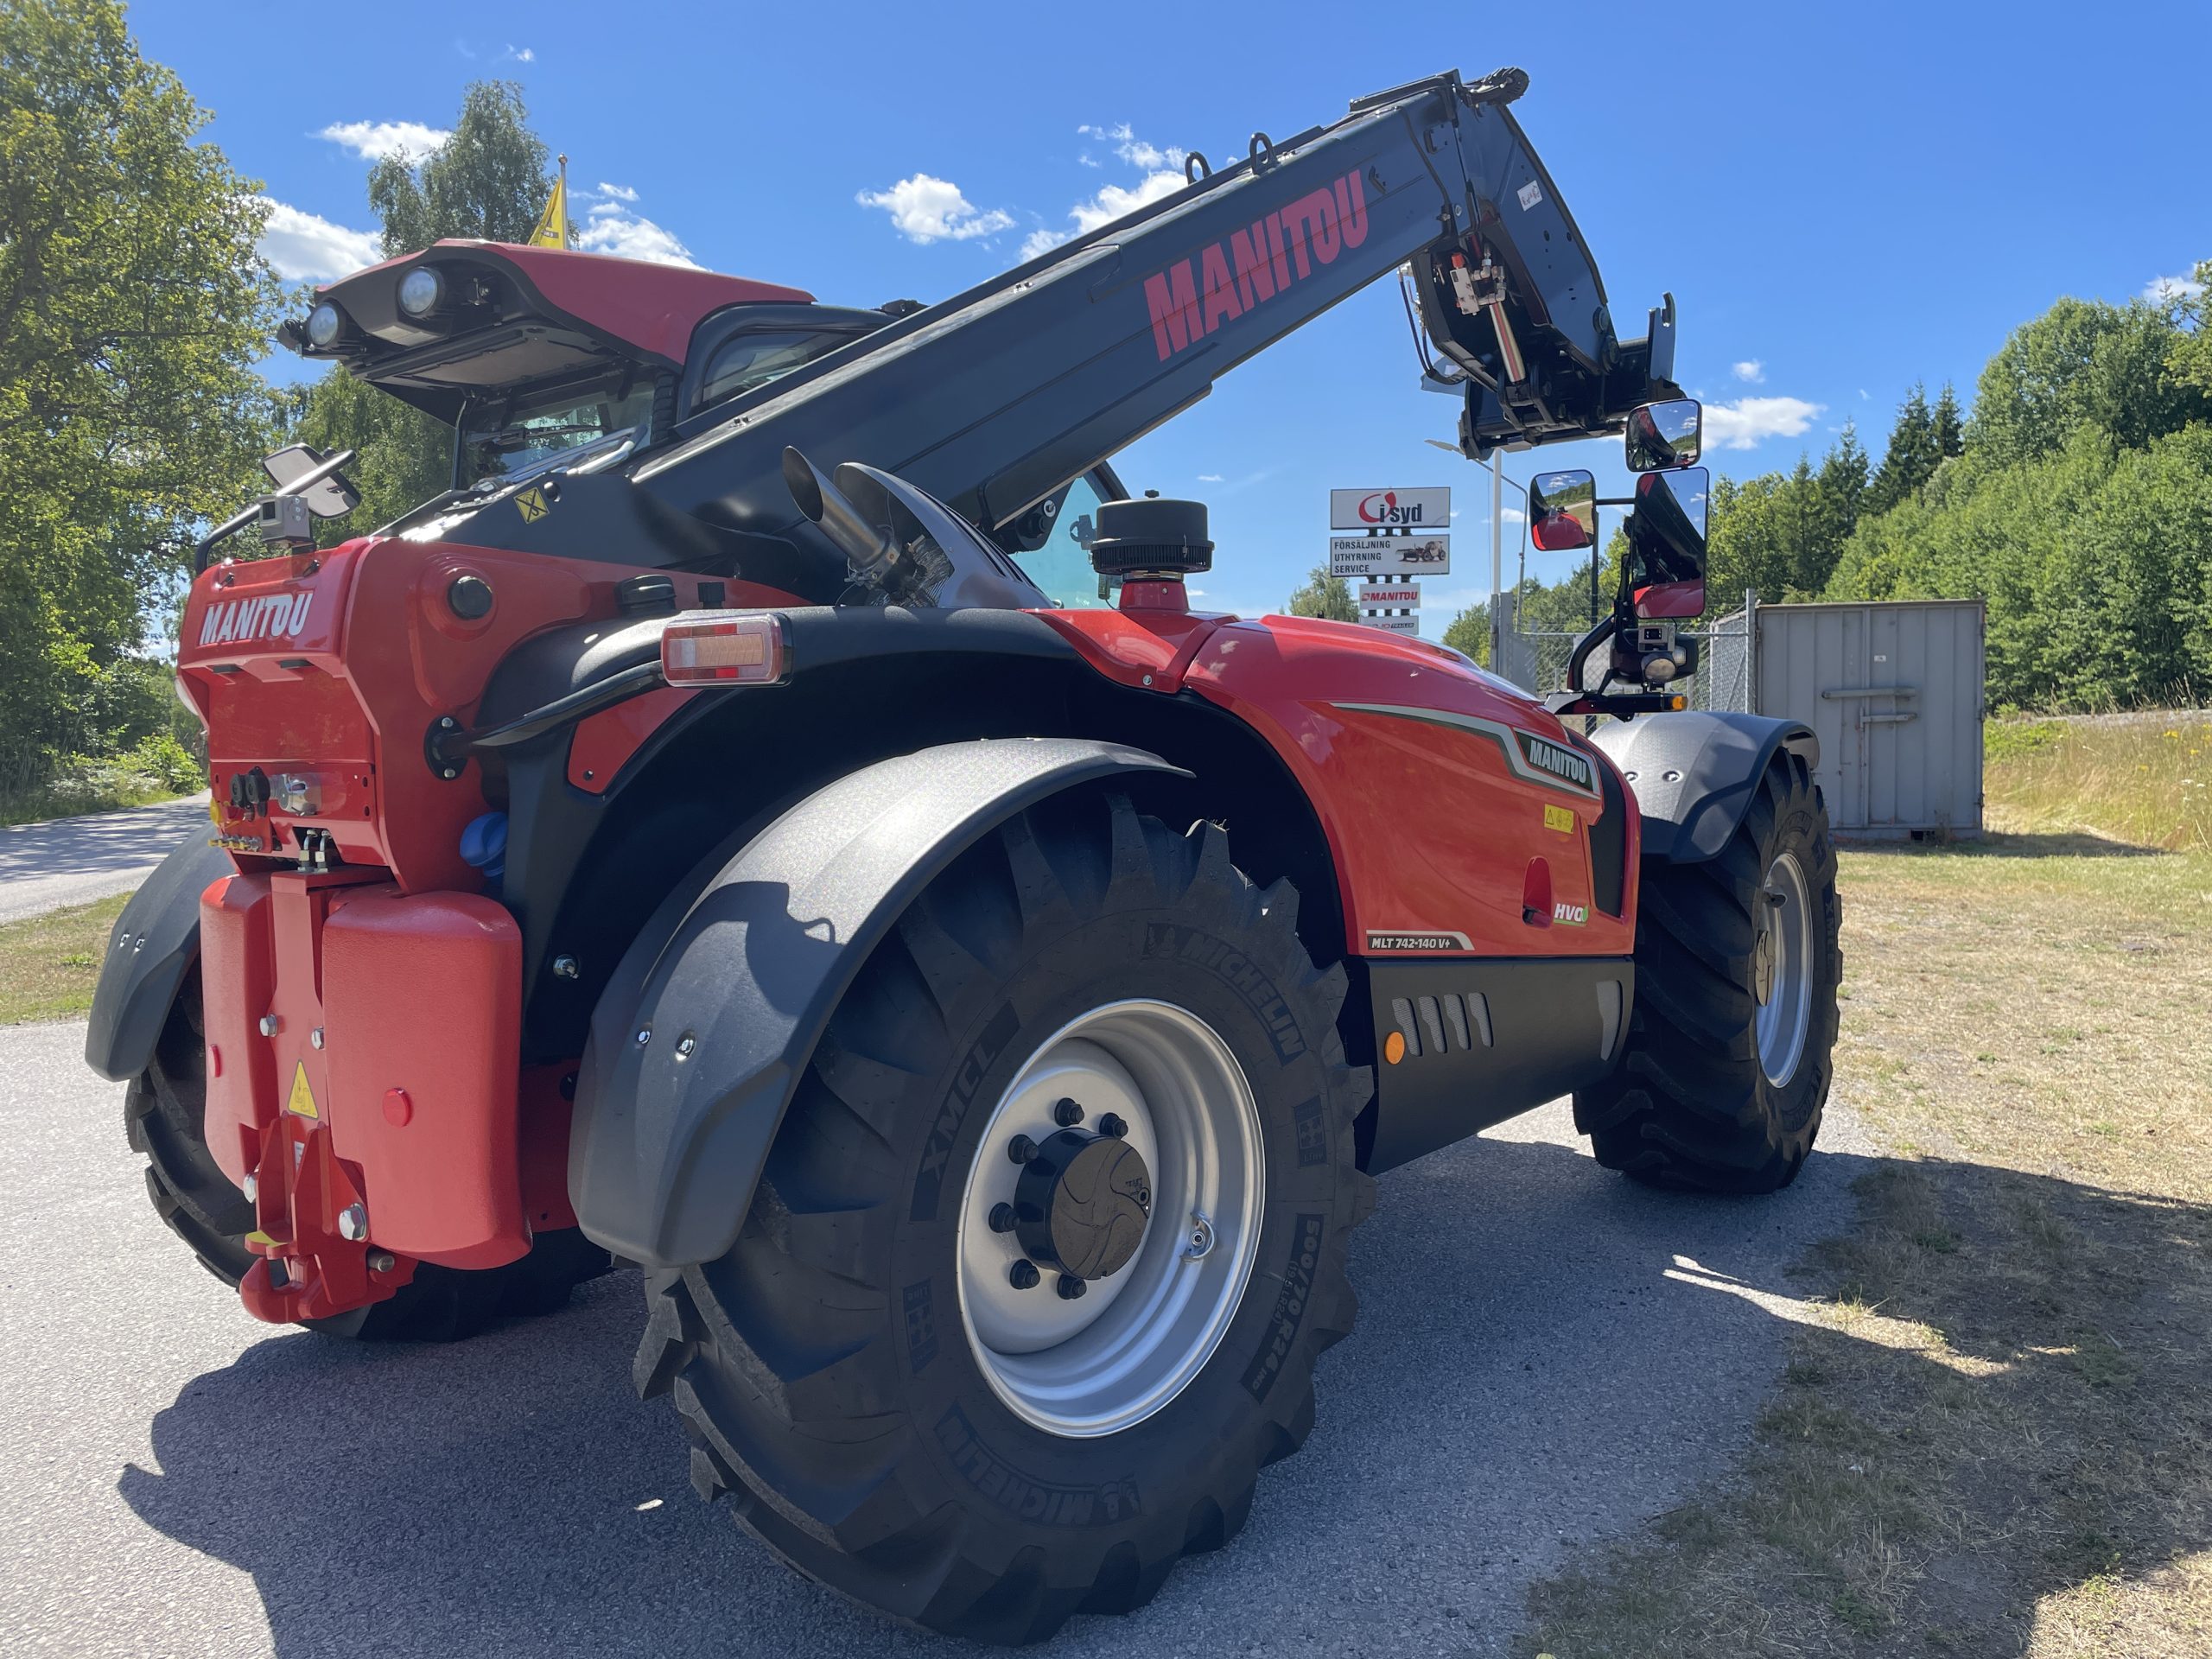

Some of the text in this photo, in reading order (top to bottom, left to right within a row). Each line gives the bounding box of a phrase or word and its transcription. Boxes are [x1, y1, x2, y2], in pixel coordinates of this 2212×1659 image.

[1143, 169, 1369, 361] MANITOU
[1334, 540, 1390, 550] FÖRSÄLJNING
[1334, 552, 1382, 562] UTHYRNING
[1334, 564, 1370, 574] SERVICE
[199, 593, 314, 645] MANITOU
[1370, 591, 1418, 601] MANITOU
[1529, 739, 1586, 784] MANITOU
[1371, 938, 1451, 949] MLT 742-140 V+
[1179, 931, 1304, 1058] MICHELIN
[921, 1042, 997, 1184] XMCL
[1288, 1219, 1320, 1316] 500/70
[936, 1414, 1095, 1528] MICHELIN
